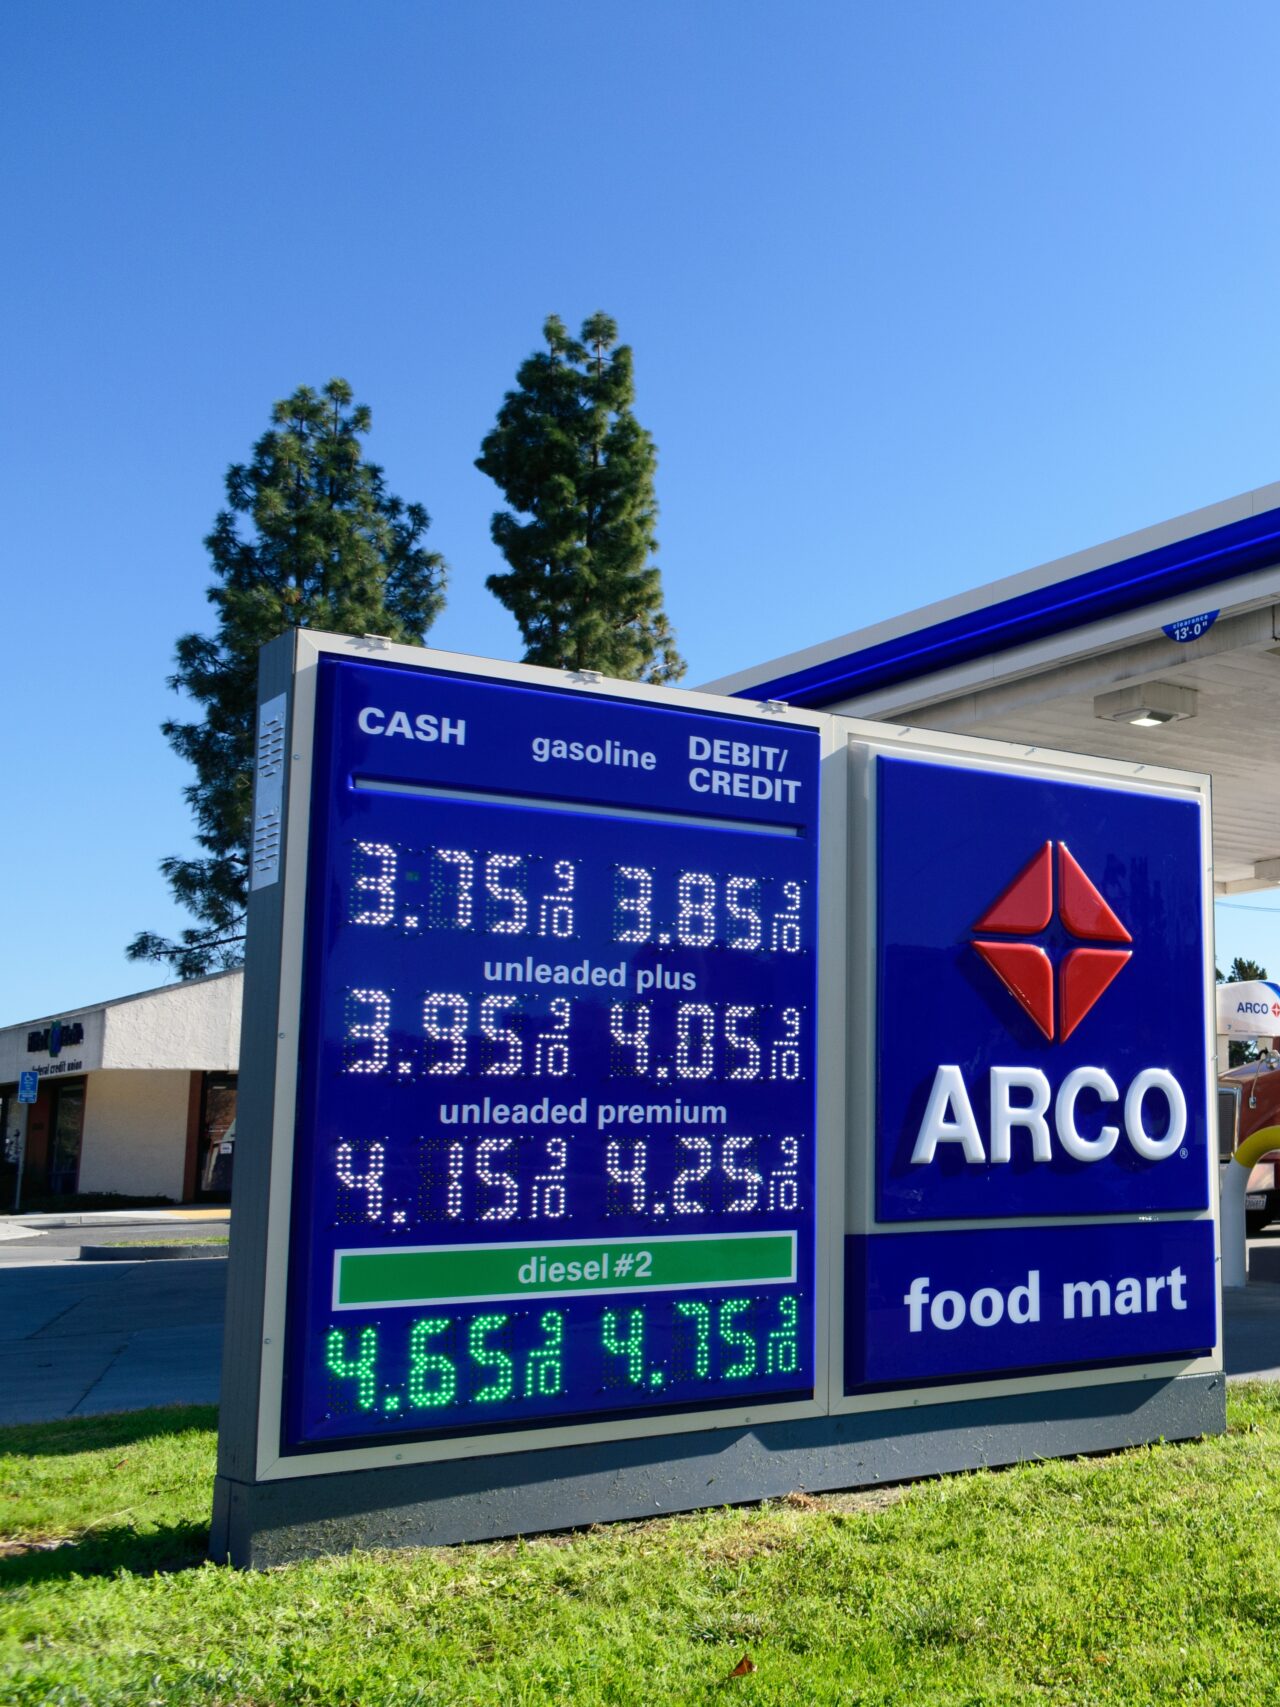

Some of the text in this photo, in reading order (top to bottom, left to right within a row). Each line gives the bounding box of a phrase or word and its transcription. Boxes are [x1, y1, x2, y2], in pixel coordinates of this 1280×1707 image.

[358, 707, 465, 745] CASH
[532, 737, 656, 770] gasoline
[689, 735, 788, 773] DEBIT/
[689, 767, 802, 803] CREDIT
[355, 842, 527, 933] 3.75
[619, 866, 762, 950] 3.85
[484, 956, 697, 991] unleaded plus
[1236, 1001, 1269, 1015] ARCO
[348, 989, 522, 1075] 3.95
[610, 1003, 761, 1079] 4.05
[440, 1097, 727, 1130] unleaded premium
[910, 1064, 1187, 1163] ARCO
[336, 1140, 518, 1223] 4.15
[606, 1137, 760, 1214] 4.25
[518, 1251, 653, 1284] diesel #2
[903, 1266, 1188, 1333] food mart
[326, 1315, 513, 1411] 4.65
[602, 1299, 757, 1384] 4.75
